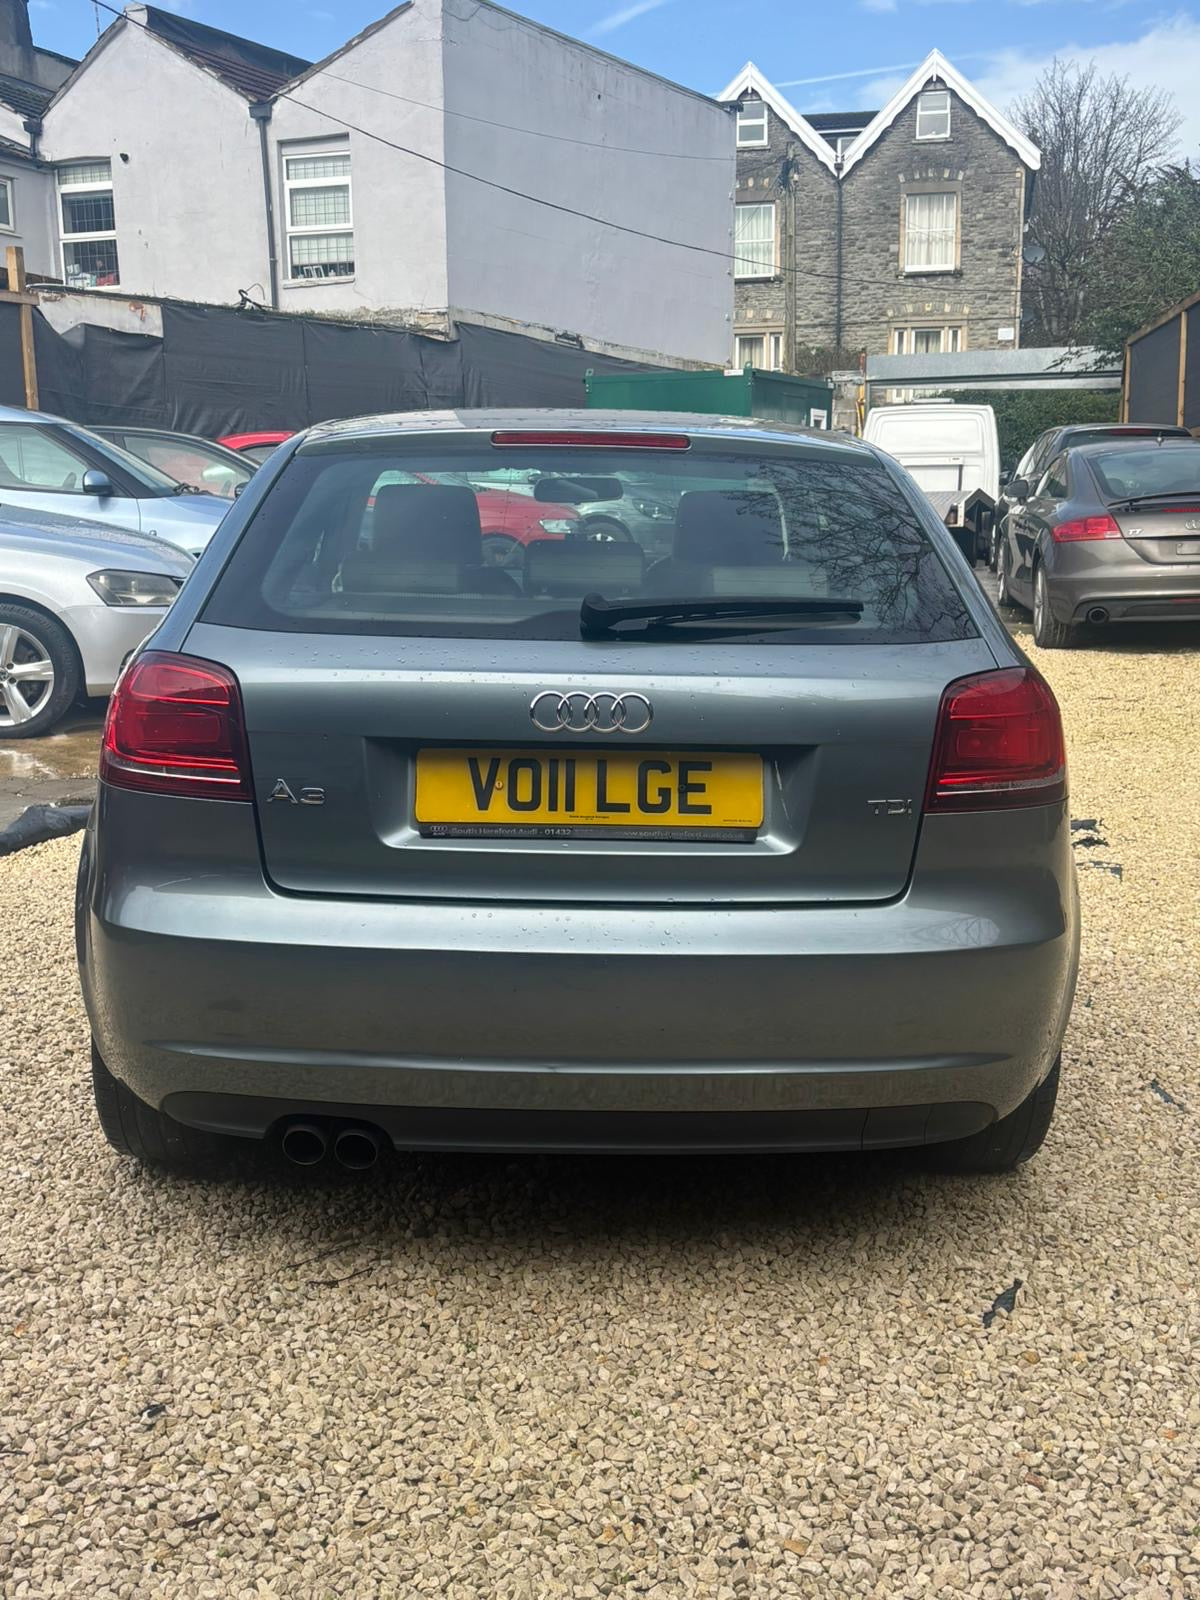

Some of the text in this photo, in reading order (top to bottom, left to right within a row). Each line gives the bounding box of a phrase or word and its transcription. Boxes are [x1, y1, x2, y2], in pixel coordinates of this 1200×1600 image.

[266, 778, 325, 805] A3
[468, 757, 713, 815] VO11 LGE
[867, 798, 913, 815] TDI
[544, 828, 572, 836] 01432
